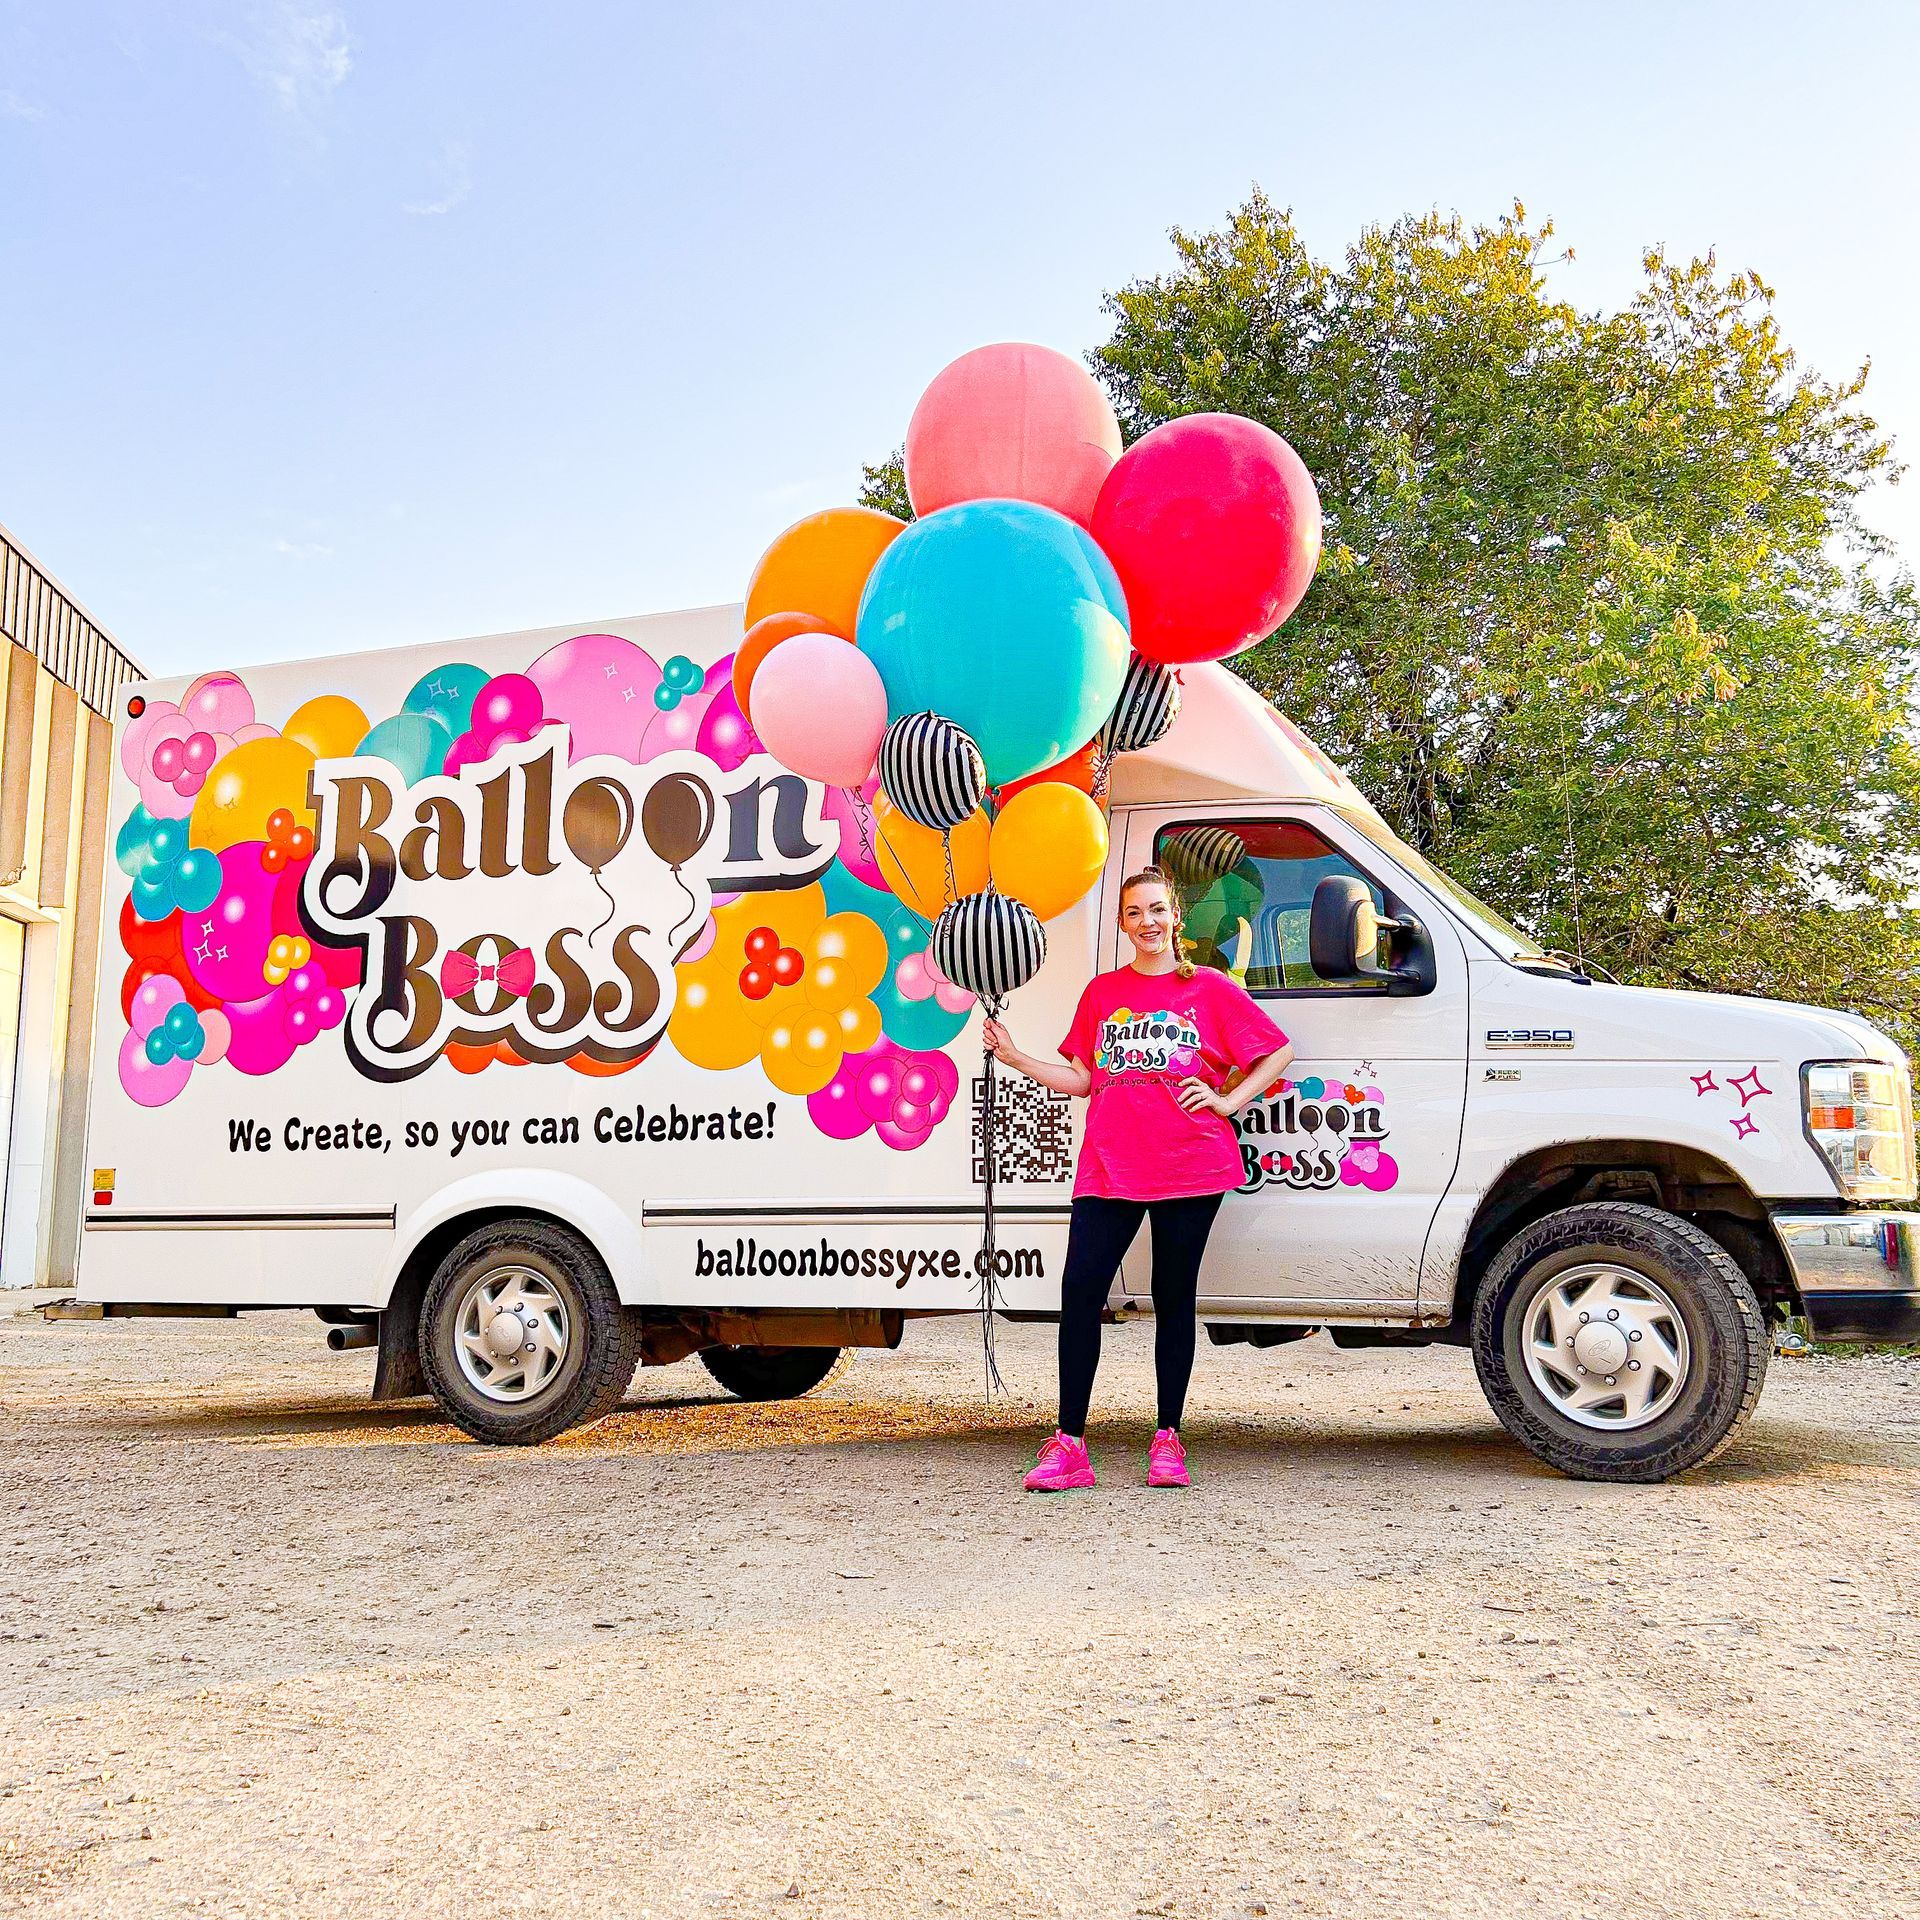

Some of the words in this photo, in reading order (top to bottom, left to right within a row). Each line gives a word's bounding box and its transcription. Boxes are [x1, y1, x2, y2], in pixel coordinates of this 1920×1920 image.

[316, 745, 823, 920] Balloon
[366, 913, 661, 1054] Boss
[1103, 1020, 1199, 1051] Balloon
[1110, 1045, 1167, 1071] Boss
[228, 1118, 272, 1153] We
[284, 1116, 392, 1154] Create,
[405, 1121, 439, 1148] so
[450, 1119, 510, 1158] you
[523, 1116, 579, 1145] can
[593, 1101, 777, 1143] Celebrate!
[694, 1237, 1044, 1290] balloonbossyxe.com
